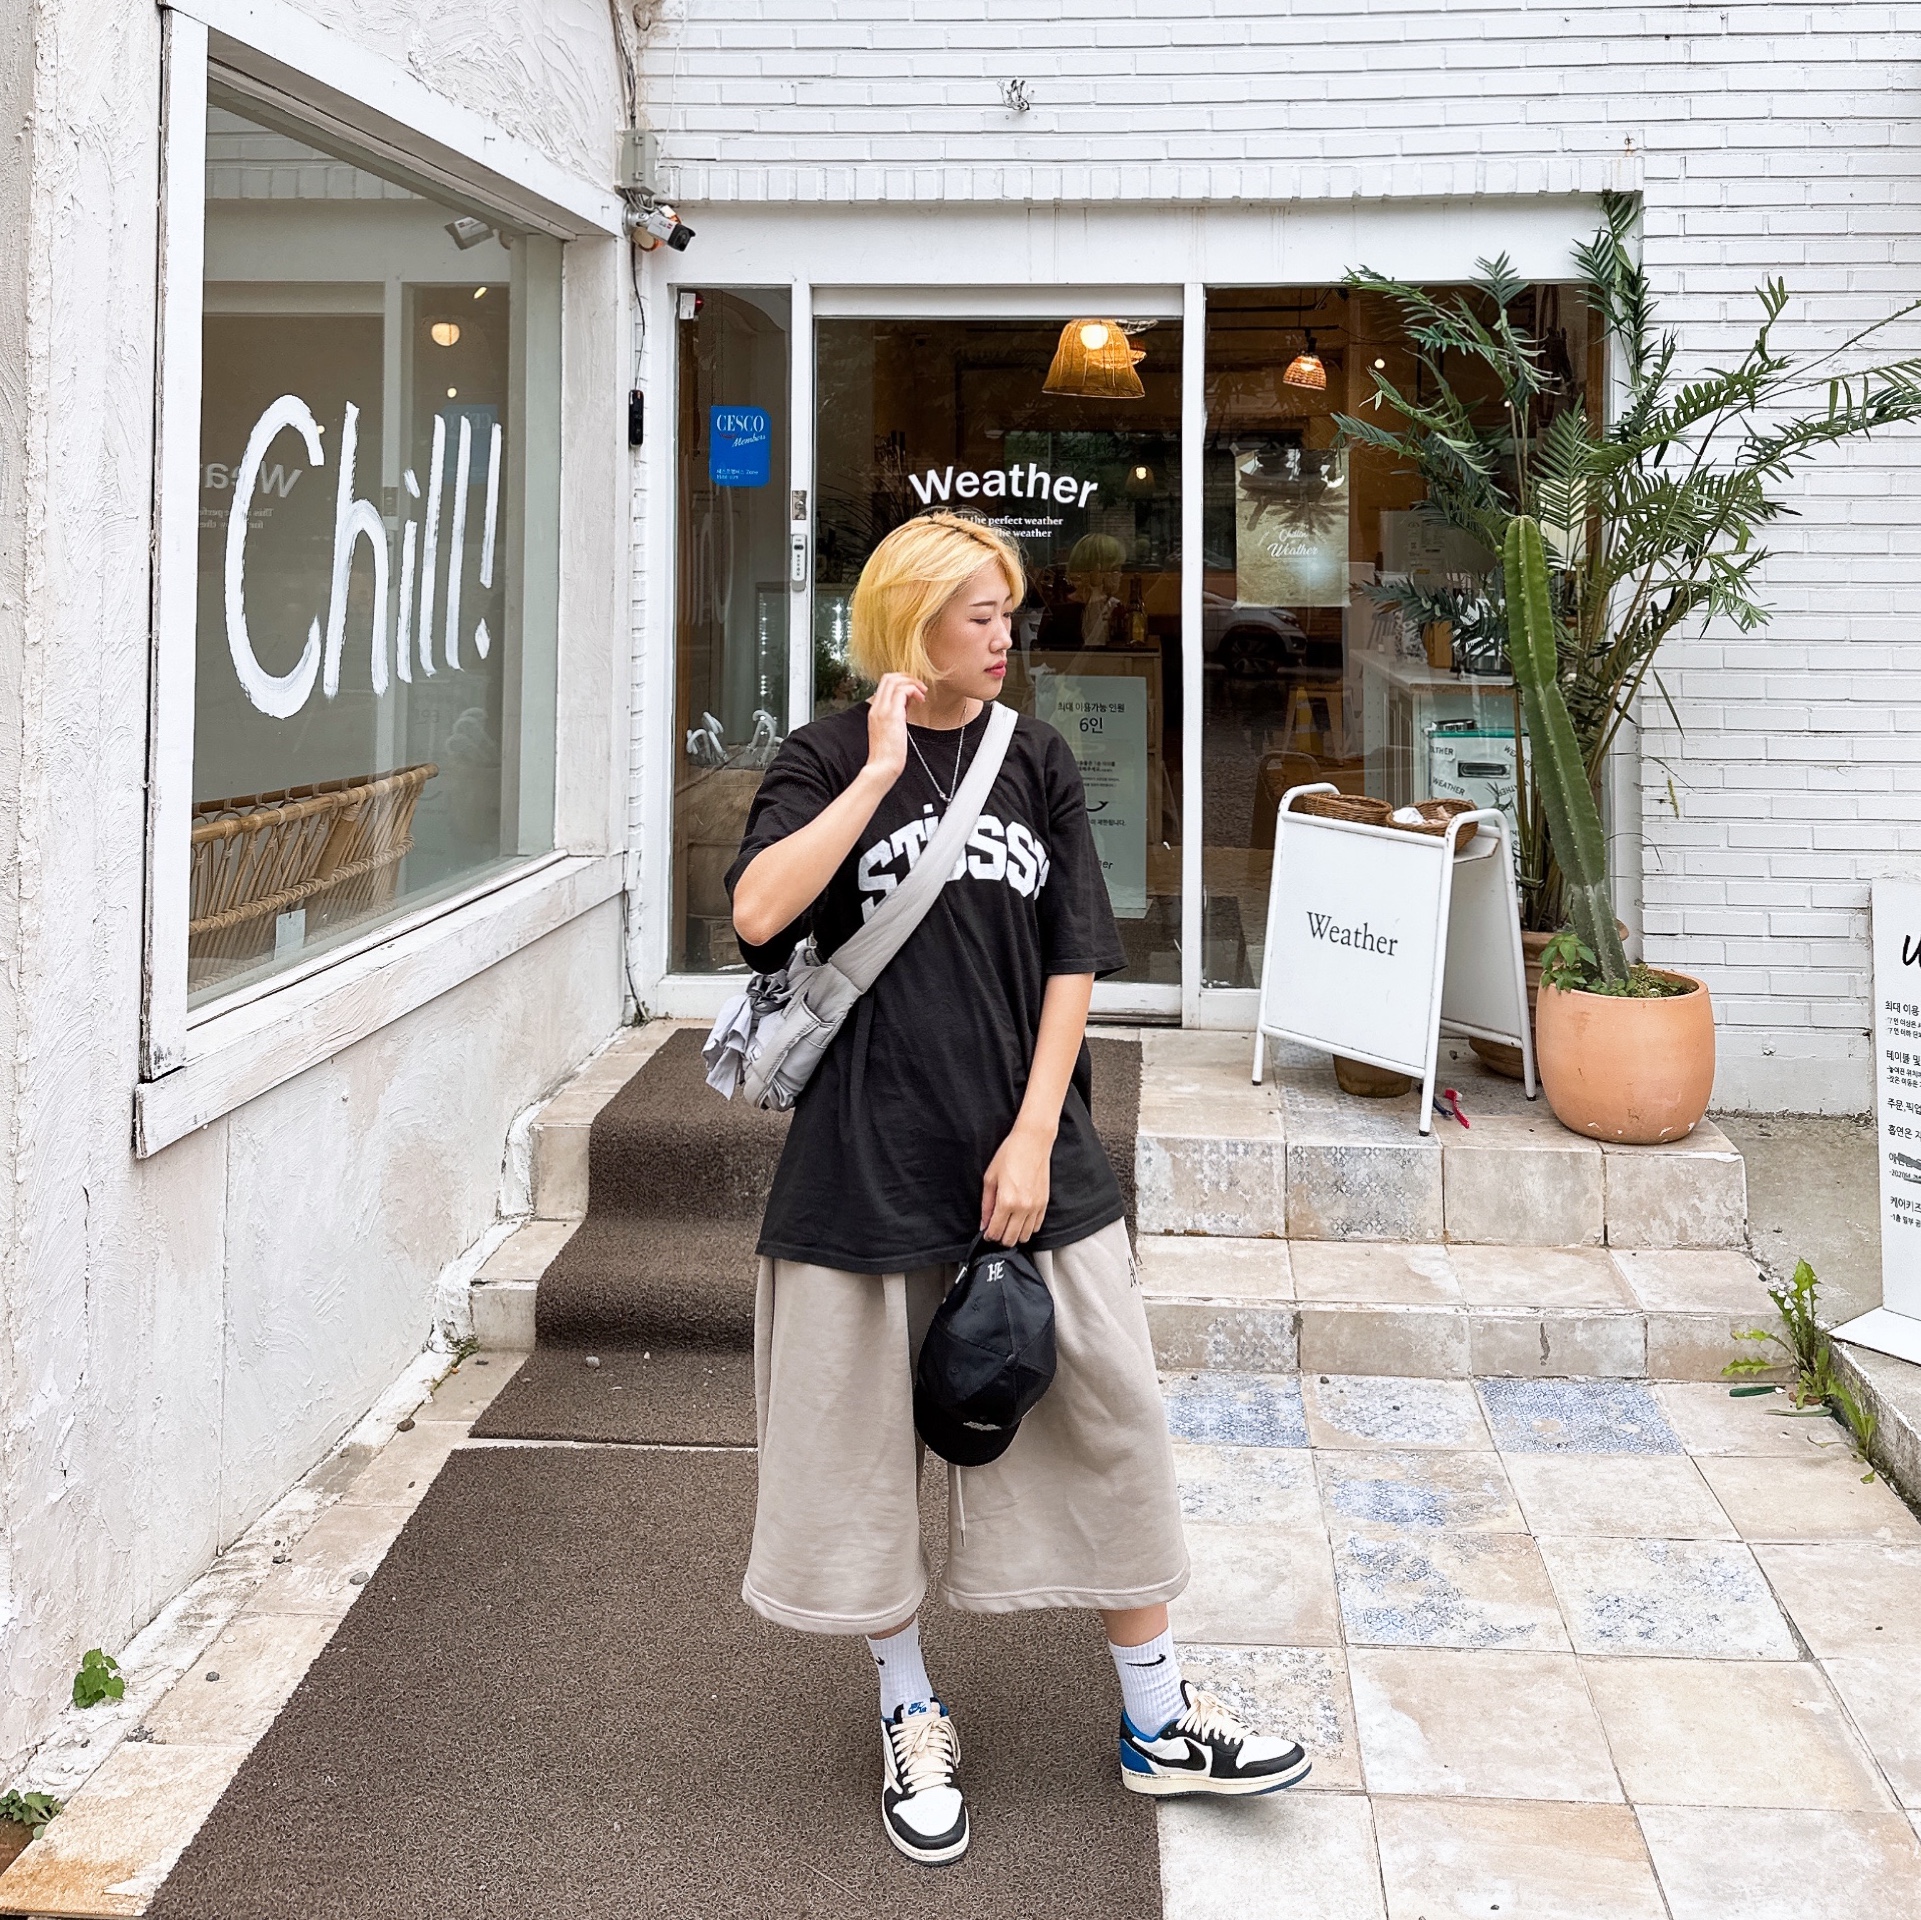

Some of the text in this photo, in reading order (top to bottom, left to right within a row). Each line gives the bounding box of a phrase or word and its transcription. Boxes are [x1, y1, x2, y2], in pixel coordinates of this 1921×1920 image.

[716, 414, 765, 432] CESCO
[908, 462, 1098, 508] Weather
[988, 515, 1022, 526] perfect
[1024, 516, 1064, 525] weather
[1012, 528, 1053, 538] weather
[225, 394, 502, 720] Chill!
[1266, 543, 1318, 557] Weather
[1057, 702, 1125, 713] 최대 이용가능 인원
[1079, 717, 1104, 734] 6인
[1432, 777, 1466, 796] WEATHER
[1306, 911, 1398, 957] Weather
[1885, 1000, 1901, 1014] 최대
[1886, 1049, 1911, 1065] 테이블
